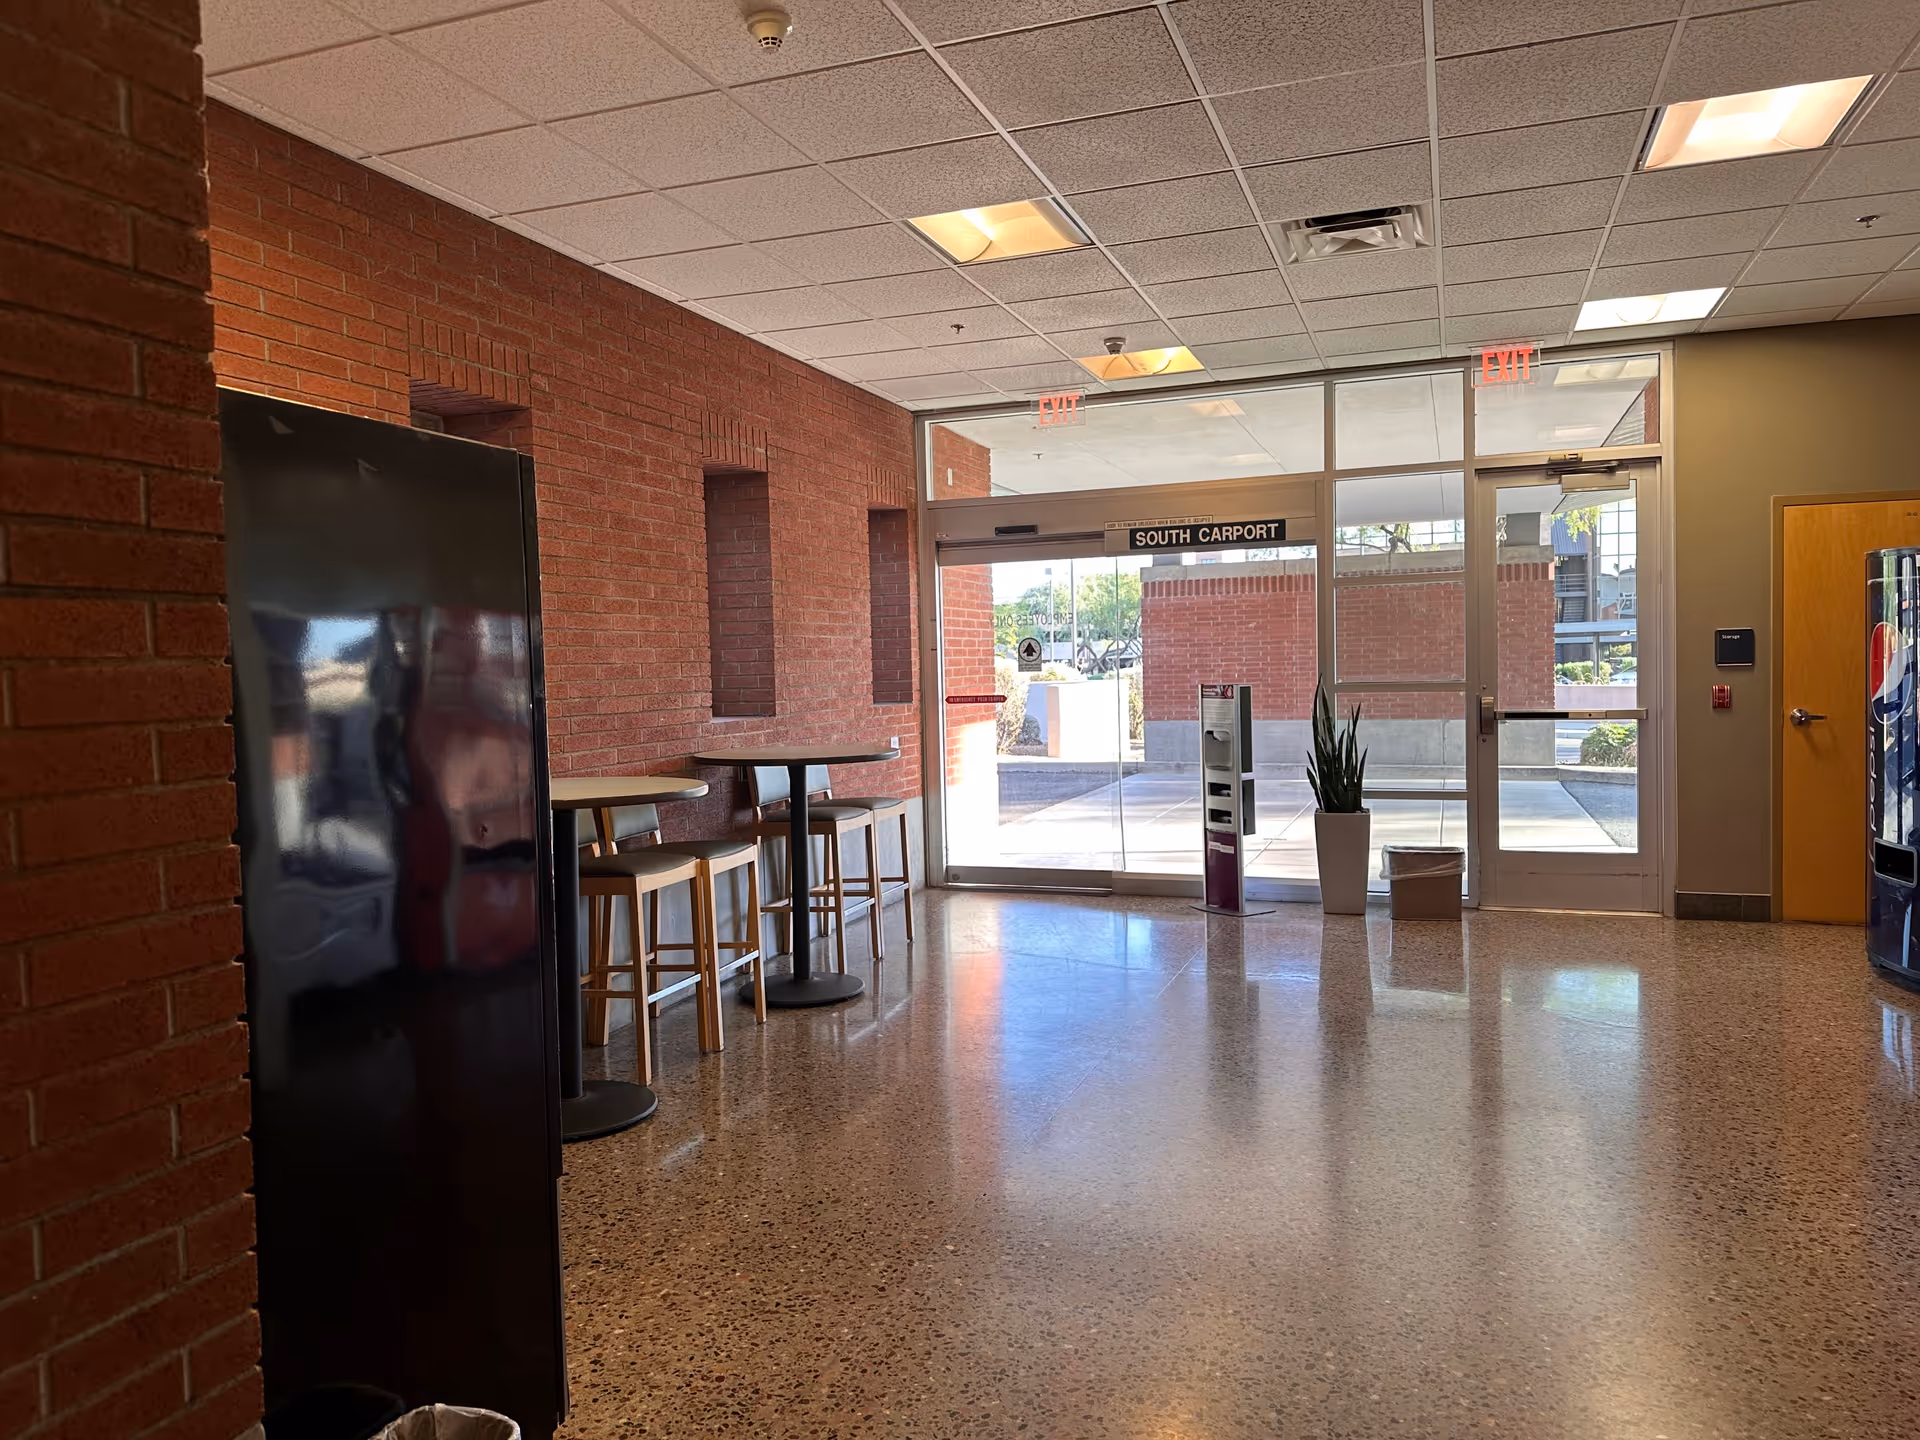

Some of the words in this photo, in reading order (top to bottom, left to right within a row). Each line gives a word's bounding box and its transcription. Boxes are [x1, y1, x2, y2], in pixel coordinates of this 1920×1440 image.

[1481, 347, 1533, 384] EXIT
[1039, 392, 1080, 425] EXIT
[1135, 528, 1191, 546] SOUTH
[1198, 523, 1279, 543] CARPORT
[1869, 726, 1877, 832] pepsi
